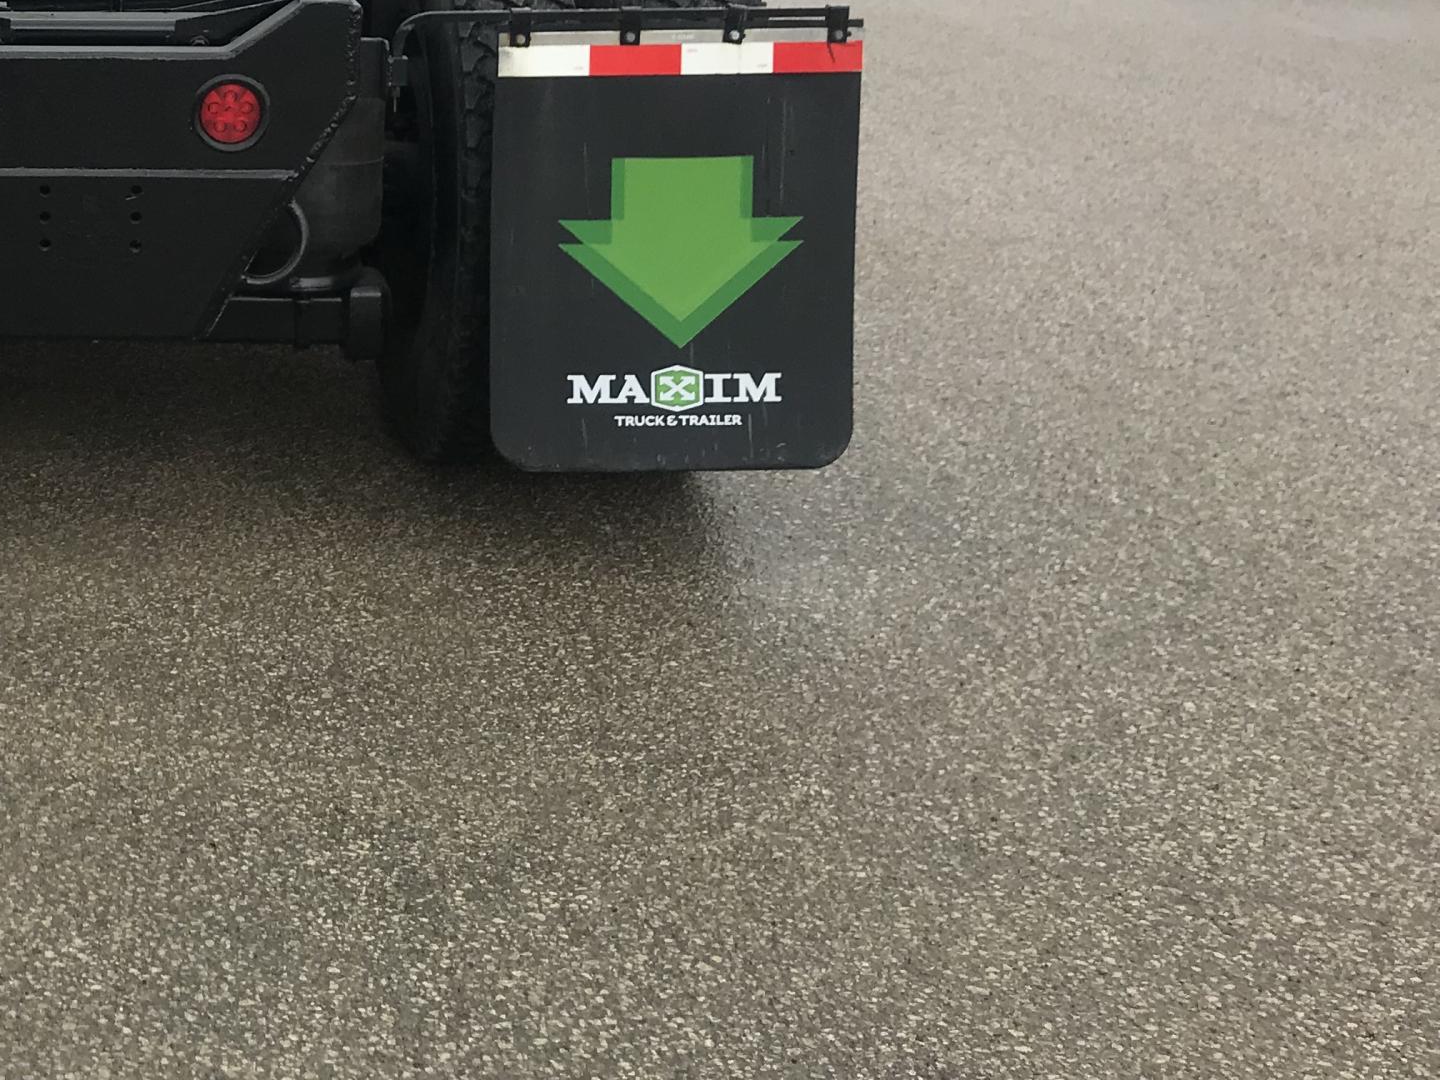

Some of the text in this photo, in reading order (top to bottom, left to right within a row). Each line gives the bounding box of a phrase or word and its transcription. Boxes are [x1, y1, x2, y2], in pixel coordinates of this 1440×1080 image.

[566, 368, 782, 409] MAXIM
[614, 415, 666, 428] TRUCK
[679, 414, 743, 427] TRAILER
